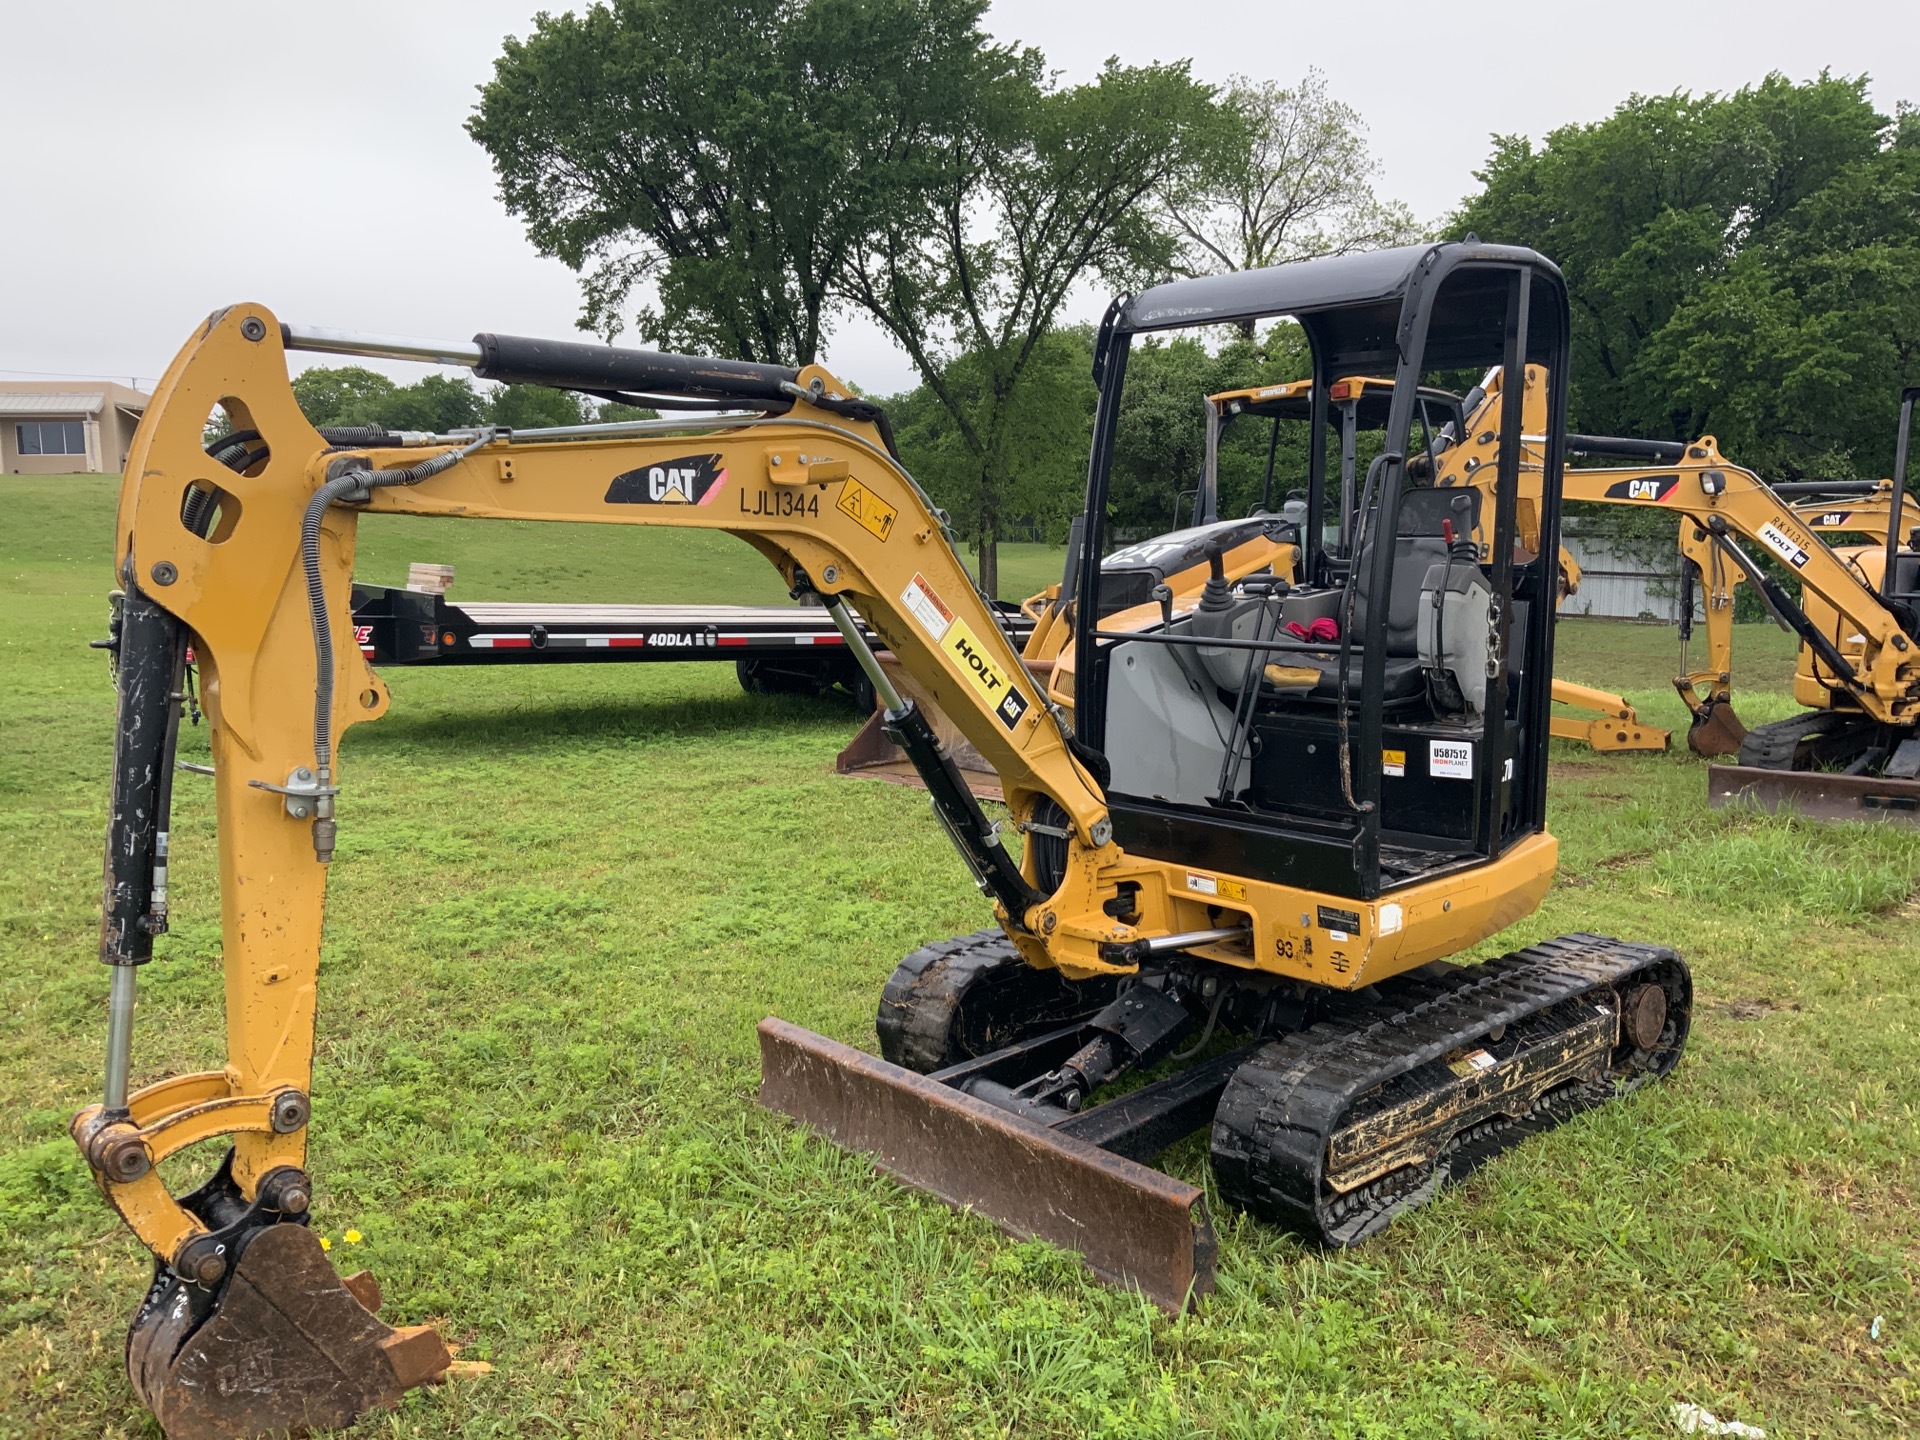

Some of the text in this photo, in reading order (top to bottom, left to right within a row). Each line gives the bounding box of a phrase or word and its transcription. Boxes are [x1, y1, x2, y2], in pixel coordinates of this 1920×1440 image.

[649, 466, 696, 502] CAT
[1628, 480, 1660, 500] CAT
[740, 487, 819, 518] LJL1344
[1823, 514, 1841, 526] CAT
[1764, 530, 1793, 551] HOLT
[1770, 516, 1811, 550] RKY1315
[924, 587, 947, 616] WARNING
[648, 633, 693, 646] 40DLA
[954, 638, 1023, 719] HOLT CAT
[1433, 748, 1468, 760] U587512
